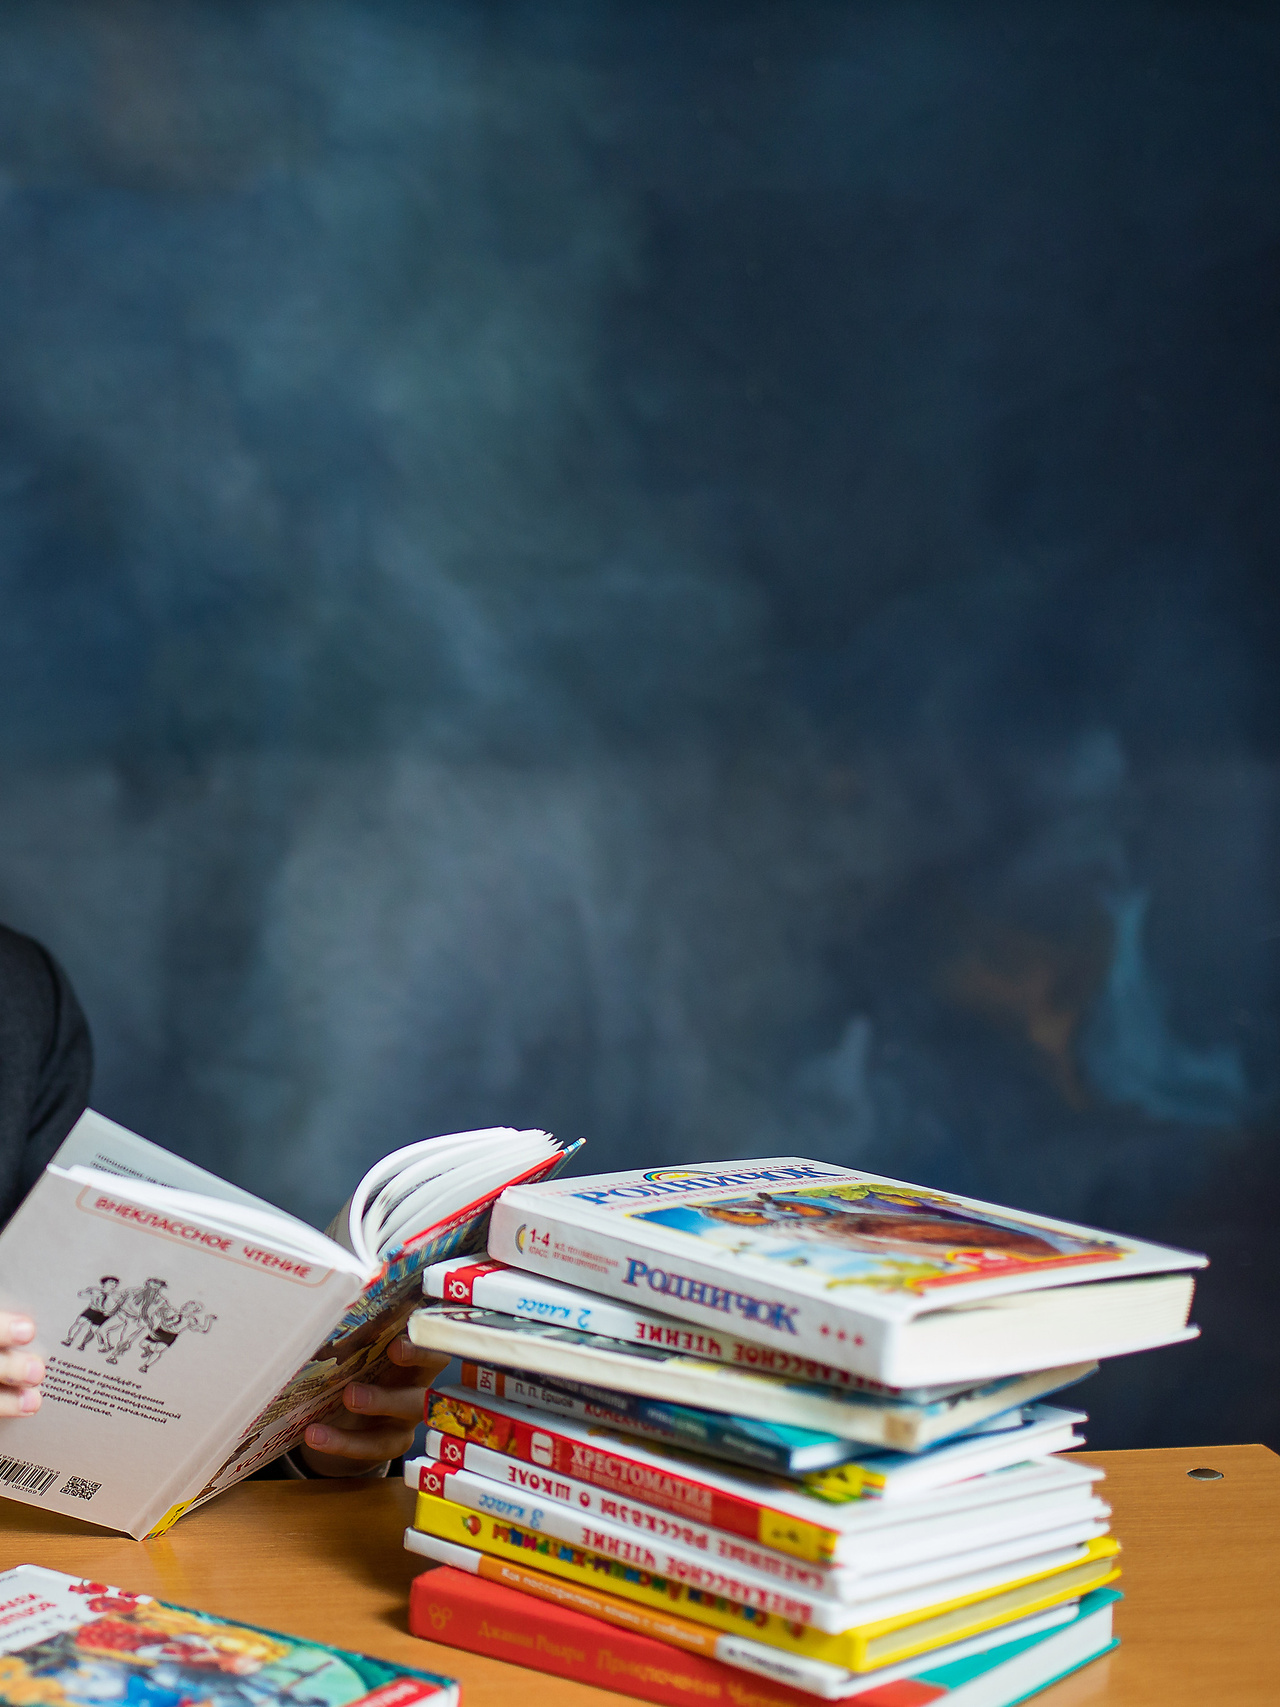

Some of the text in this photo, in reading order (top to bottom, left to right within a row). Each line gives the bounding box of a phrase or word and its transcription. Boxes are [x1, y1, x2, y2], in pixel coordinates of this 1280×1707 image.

[571, 1167, 846, 1206] РОДНИЧОК
[94, 1196, 314, 1280] ВНЕКЛАССНОЕ ЧТЕНИЕ
[529, 1228, 550, 1247] 1-4
[516, 1297, 592, 1329] 2 класс
[622, 1257, 800, 1335] РОДНИЧОК
[635, 1321, 723, 1359] ЧТЕНИЕ
[45, 1365, 165, 1406] ественные произведения
[57, 1359, 86, 1373] серии
[88, 1369, 102, 1378] вы
[103, 1373, 142, 1389] найдёте
[45, 1374, 182, 1420] тературы, рекомендованной
[75, 1391, 108, 1407] чтения
[117, 1405, 167, 1425] начальной
[80, 1403, 113, 1418] школе.
[515, 1383, 574, 1409] П. П. Ершов
[262, 1397, 341, 1448] СТАРИК
[11, 1483, 38, 1495] 082569
[571, 1444, 712, 1506] ХРЕСТОМАТИЯ
[478, 1493, 545, 1530] 3 класс
[508, 1465, 824, 1591] СМЕШНЫЕ РАССКАЗЫ О ШКОЛЕ
[501, 1566, 523, 1582] Как
[581, 1527, 814, 1621] ВНЕКЛАССНОЕ ЧТЕНИЕ
[478, 1621, 534, 1648] Джанни
[596, 1650, 723, 1698] Приключения
